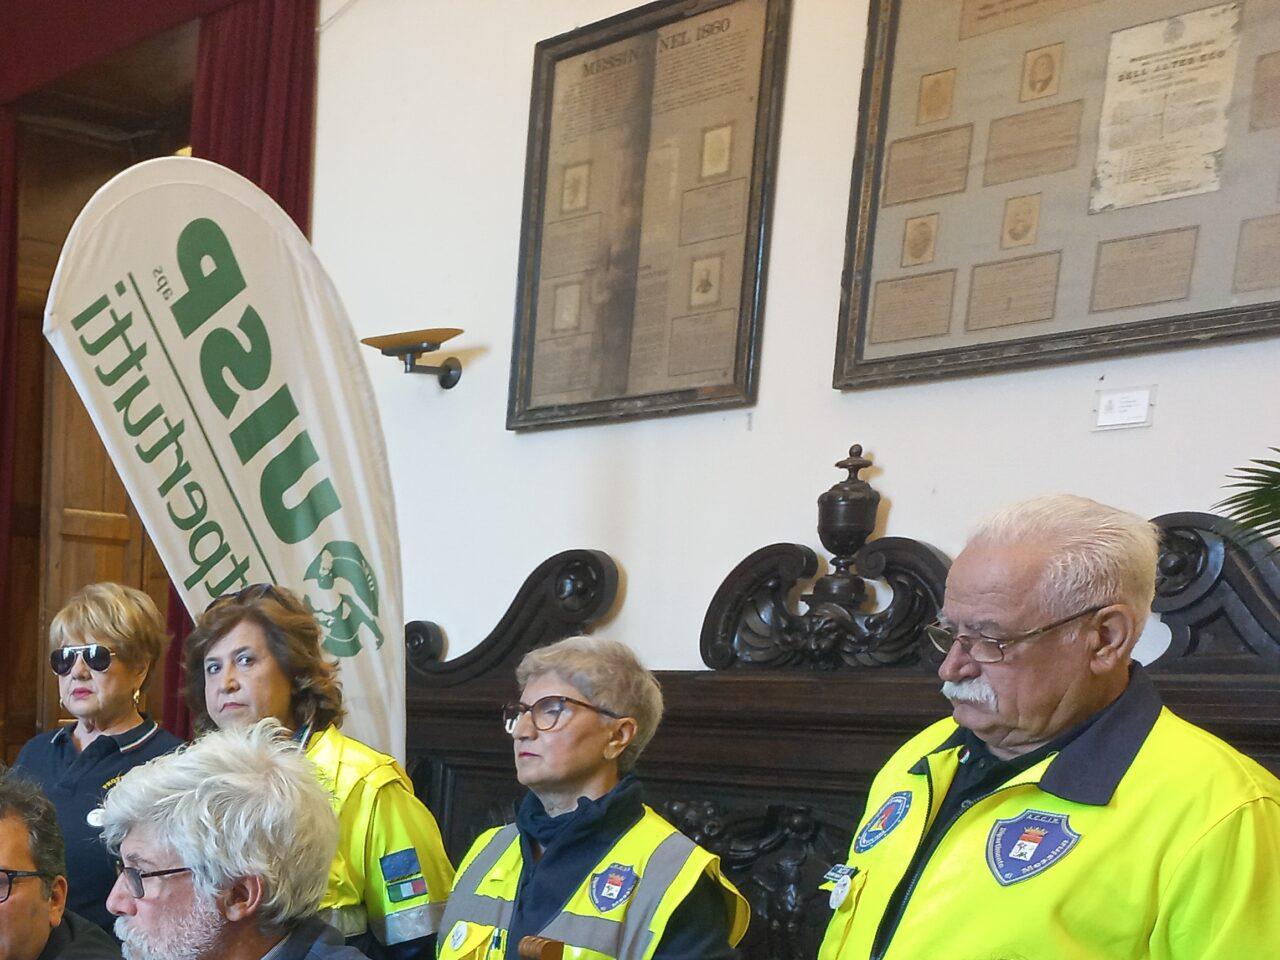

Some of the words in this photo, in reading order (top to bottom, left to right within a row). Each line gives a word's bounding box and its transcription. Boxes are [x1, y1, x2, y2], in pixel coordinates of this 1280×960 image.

[659, 31, 691, 53] NEL
[696, 17, 732, 41] 1860
[1021, 840, 1069, 874] Messina
